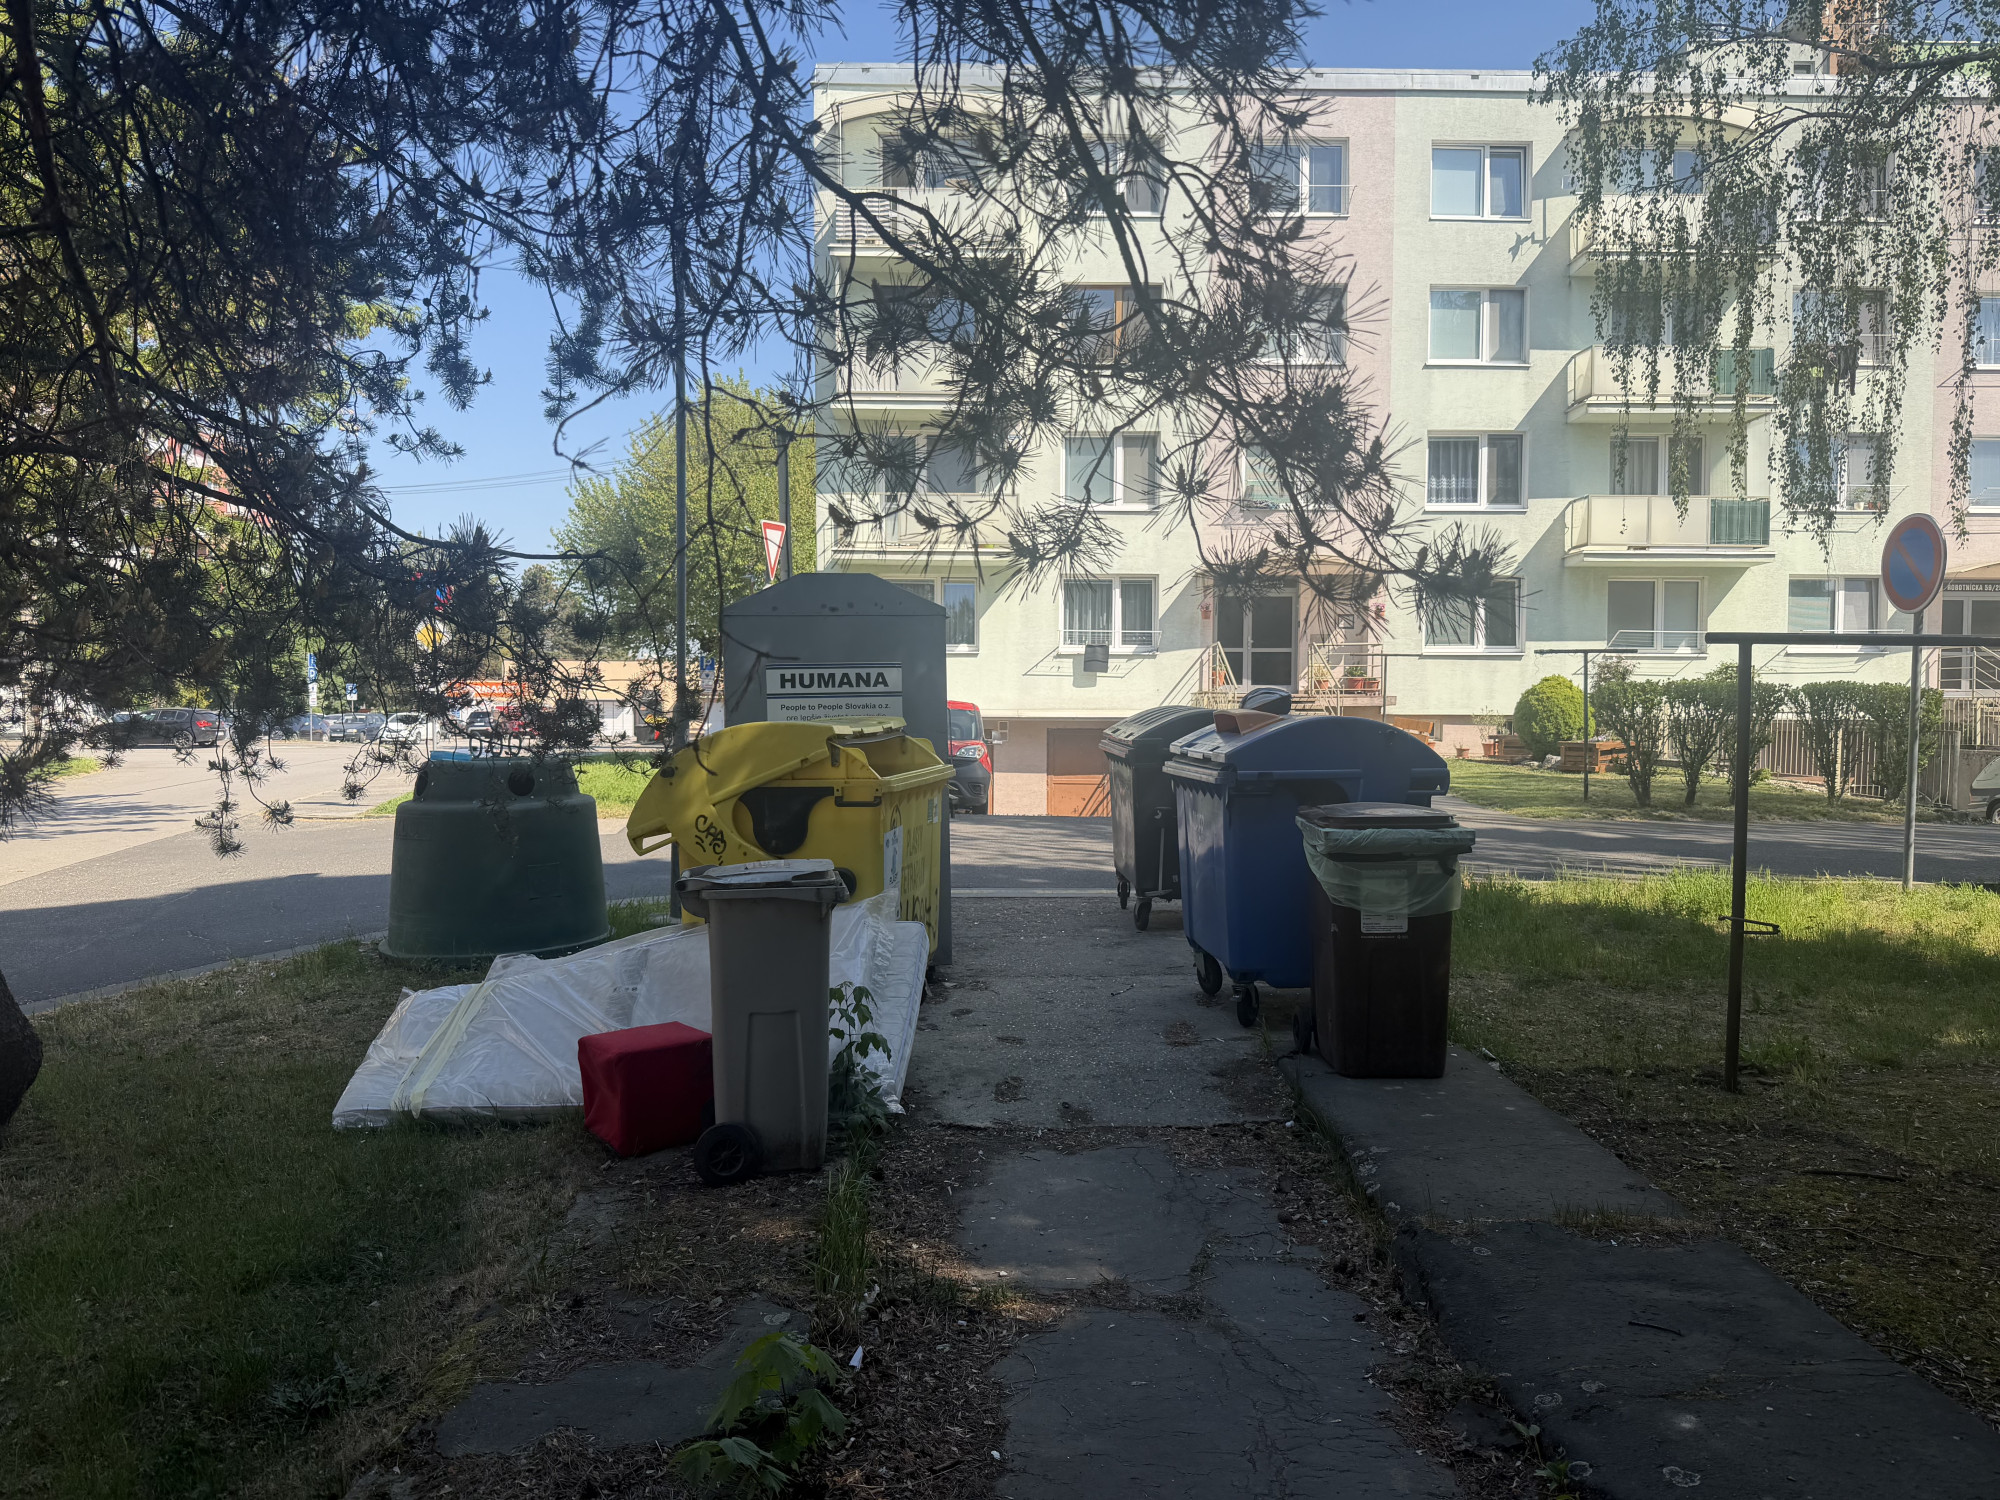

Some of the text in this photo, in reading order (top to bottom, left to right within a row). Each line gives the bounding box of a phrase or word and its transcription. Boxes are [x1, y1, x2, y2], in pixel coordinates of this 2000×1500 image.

[779, 671, 889, 689] HUMANA
[780, 704, 806, 712] People
[818, 703, 843, 711] People
[845, 702, 876, 710] Slovakia
